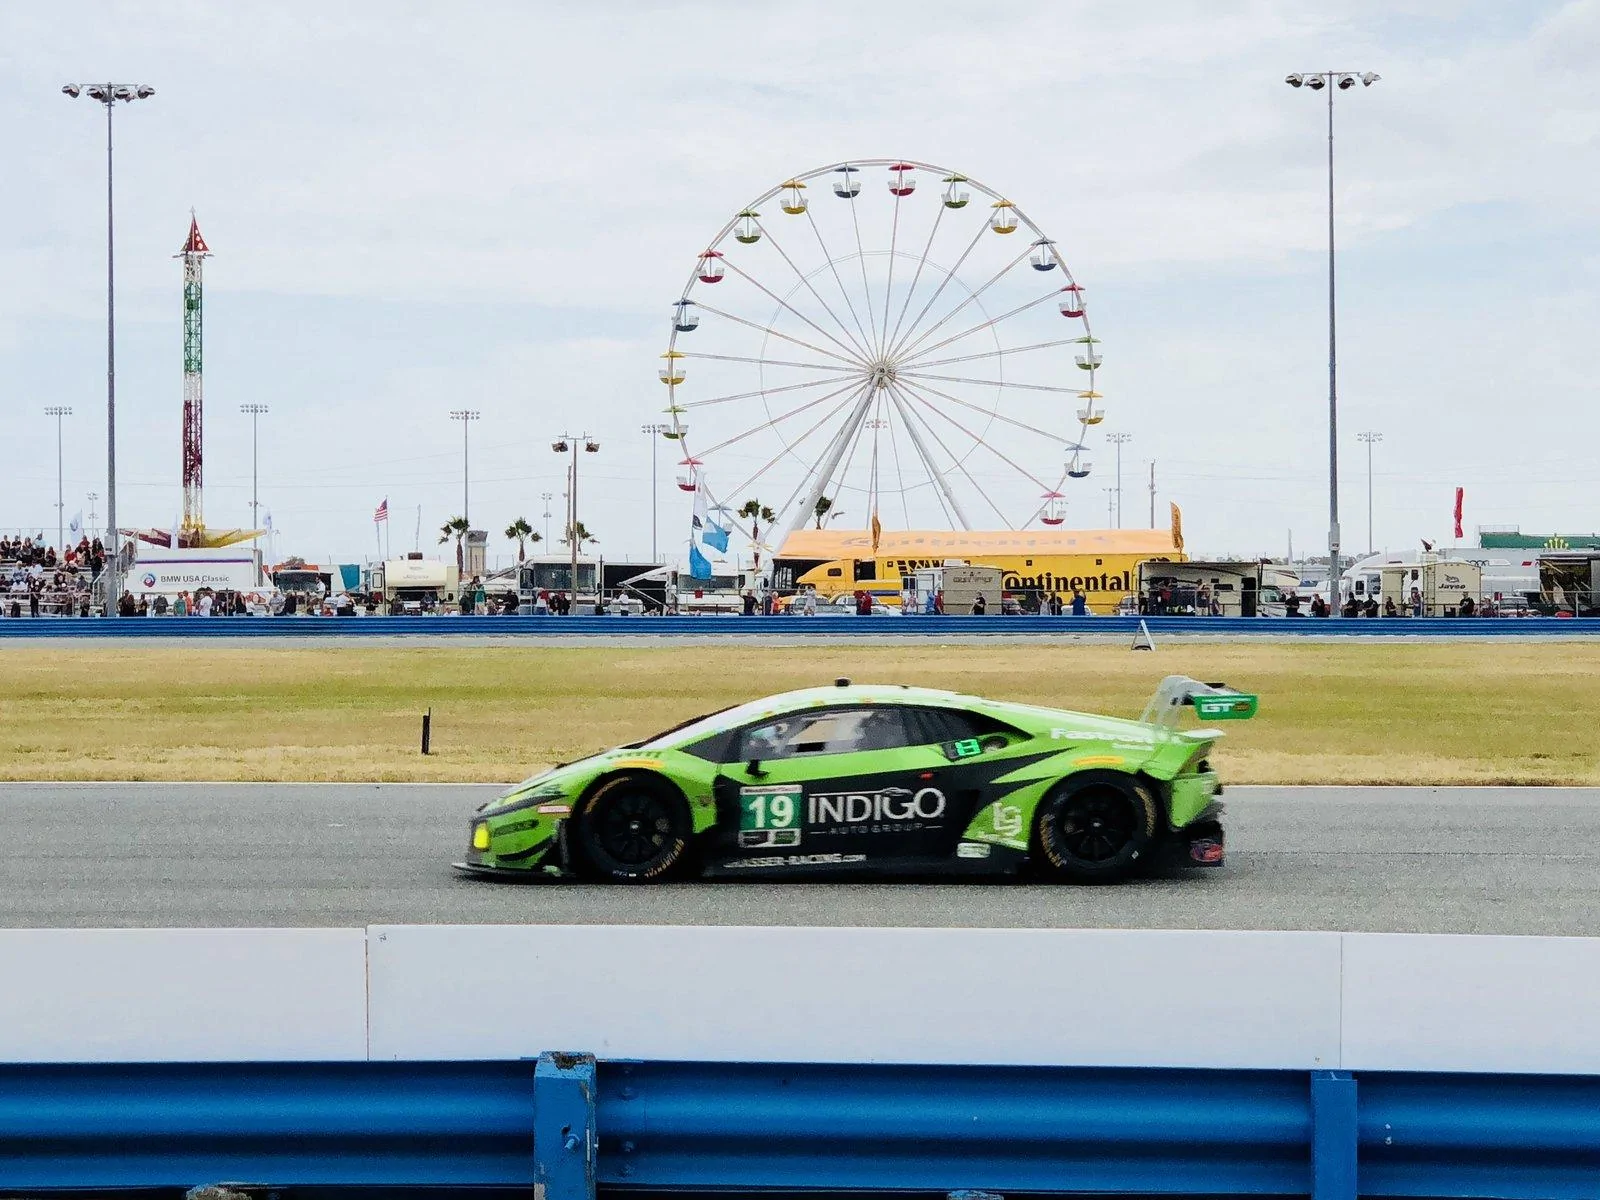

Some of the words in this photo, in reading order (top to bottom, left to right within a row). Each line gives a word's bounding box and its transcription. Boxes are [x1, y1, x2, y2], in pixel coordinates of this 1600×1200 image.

[160, 575, 181, 583] BMW
[183, 575, 201, 583] USA
[202, 575, 230, 583] Classic
[748, 795, 795, 828] 19
[808, 787, 947, 824] INDIGO
